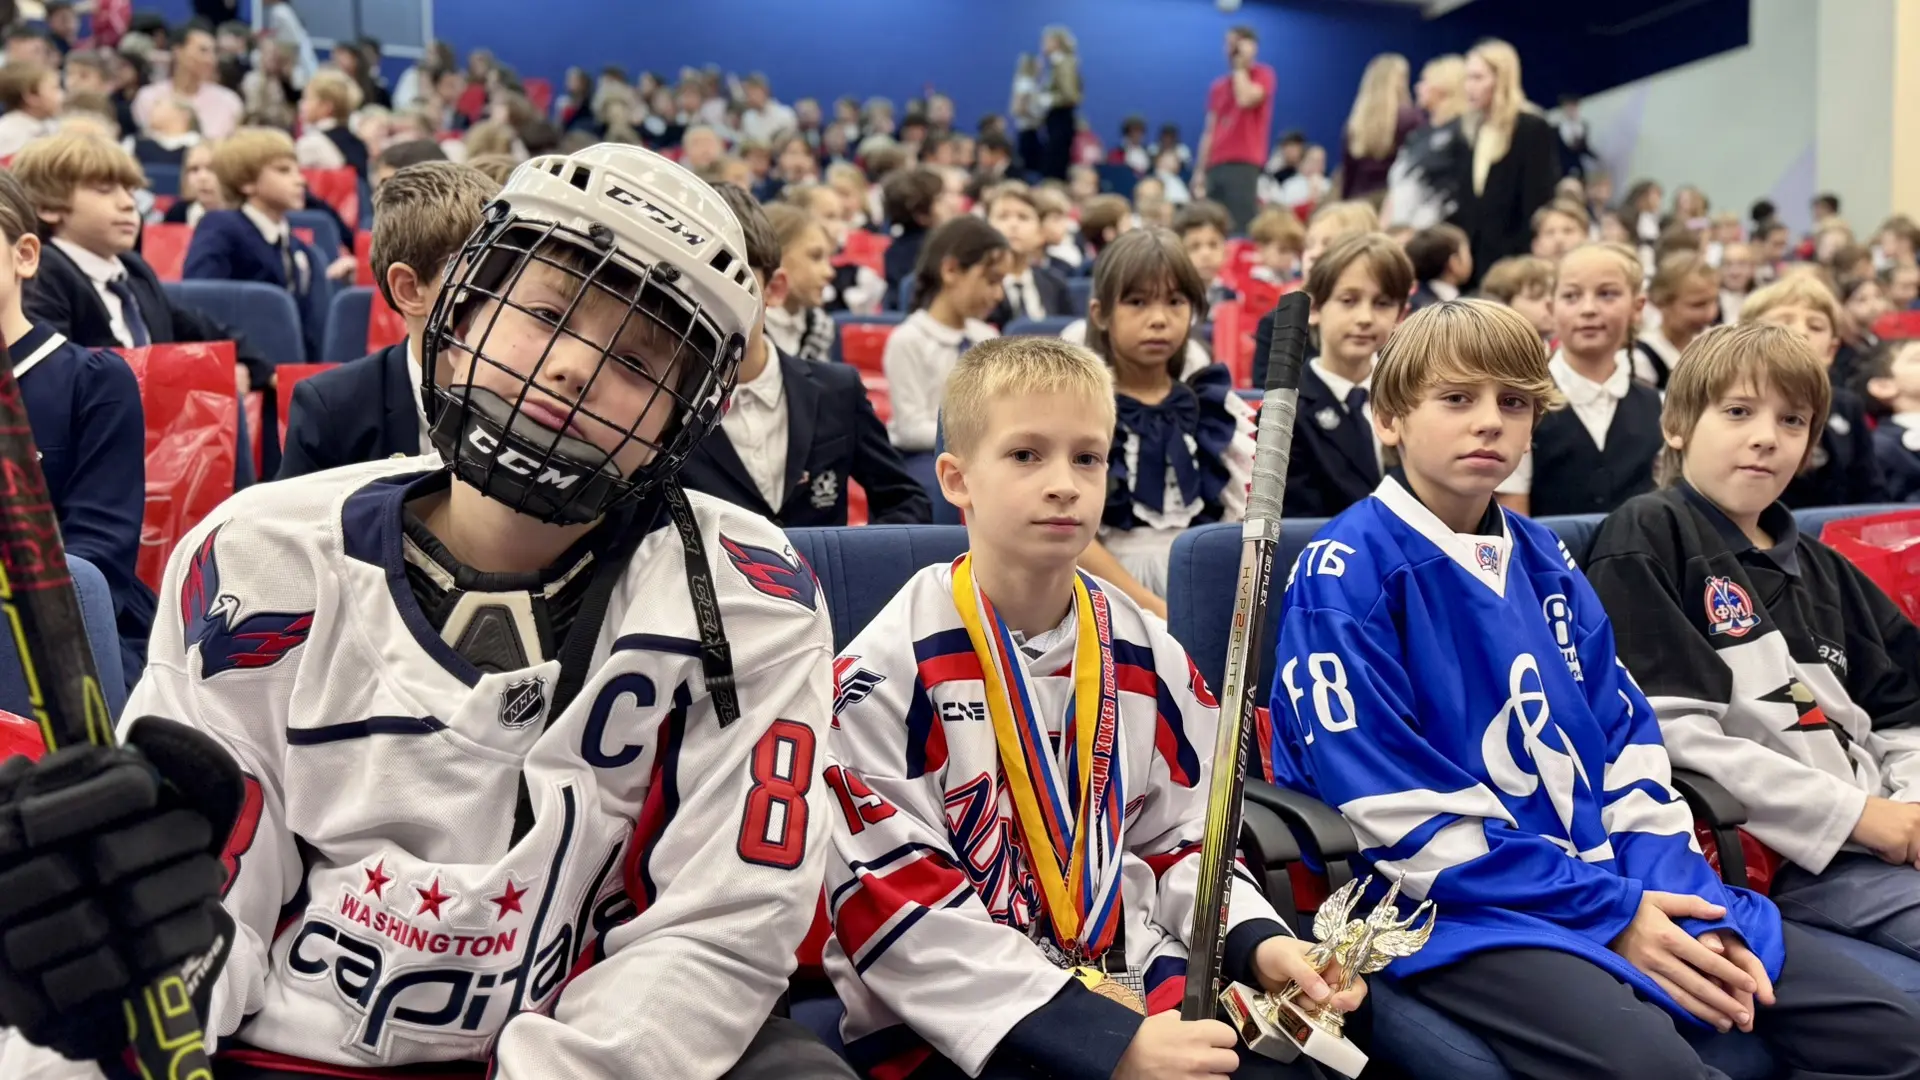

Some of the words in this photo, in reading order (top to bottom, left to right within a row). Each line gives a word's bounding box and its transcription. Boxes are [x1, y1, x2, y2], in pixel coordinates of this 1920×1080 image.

[605, 185, 705, 246] CCM
[468, 424, 580, 489] CCM
[1090, 589, 1111, 645] МОСКВЫ
[1259, 575, 1270, 607] FLEX
[1100, 648, 1116, 698] ГОРОДА
[509, 689, 537, 719] NHL
[581, 672, 656, 768] C
[1094, 700, 1116, 756] ХОККЕЯ
[1236, 706, 1255, 784] BAUER
[737, 718, 816, 870] 8
[340, 893, 518, 957] WASHINGTON
